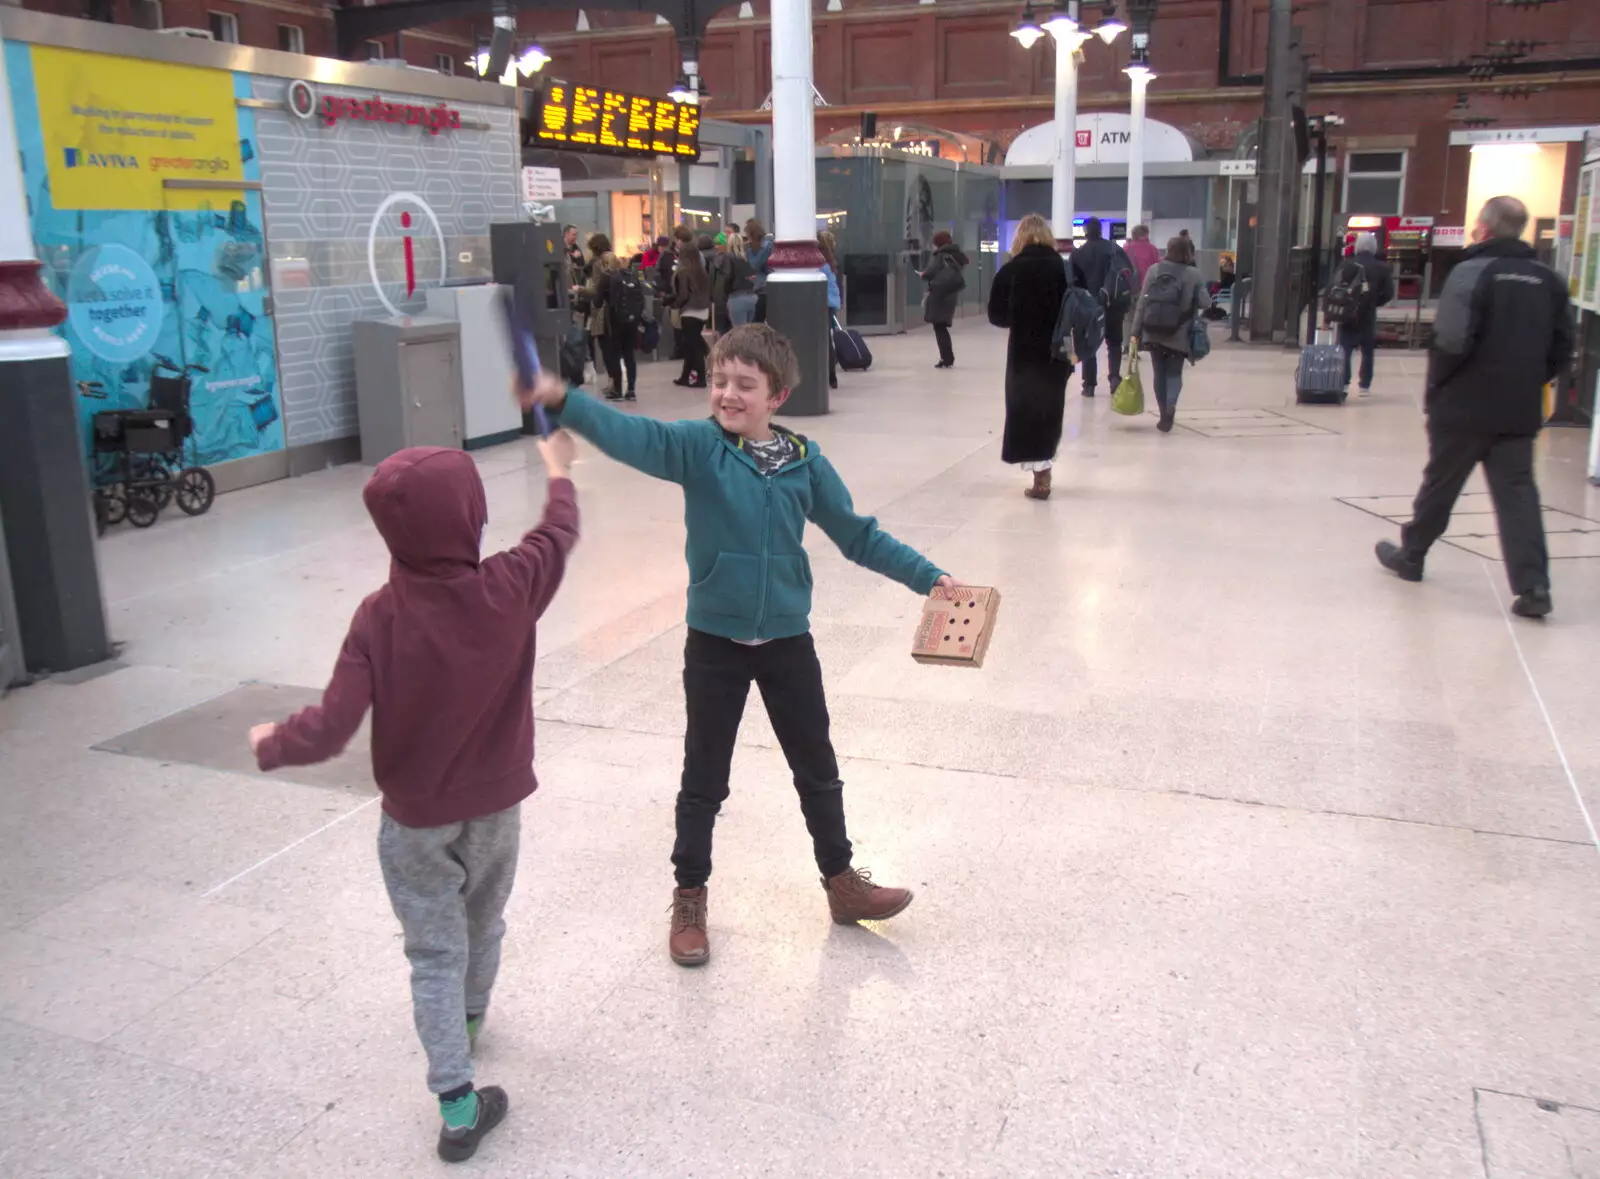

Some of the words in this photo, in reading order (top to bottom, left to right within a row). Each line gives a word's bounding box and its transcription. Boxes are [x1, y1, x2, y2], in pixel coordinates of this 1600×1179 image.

[321, 95, 461, 135] greateranglia
[1100, 131, 1131, 144] ATM
[87, 153, 139, 168] AVIVA
[88, 303, 147, 323] together
